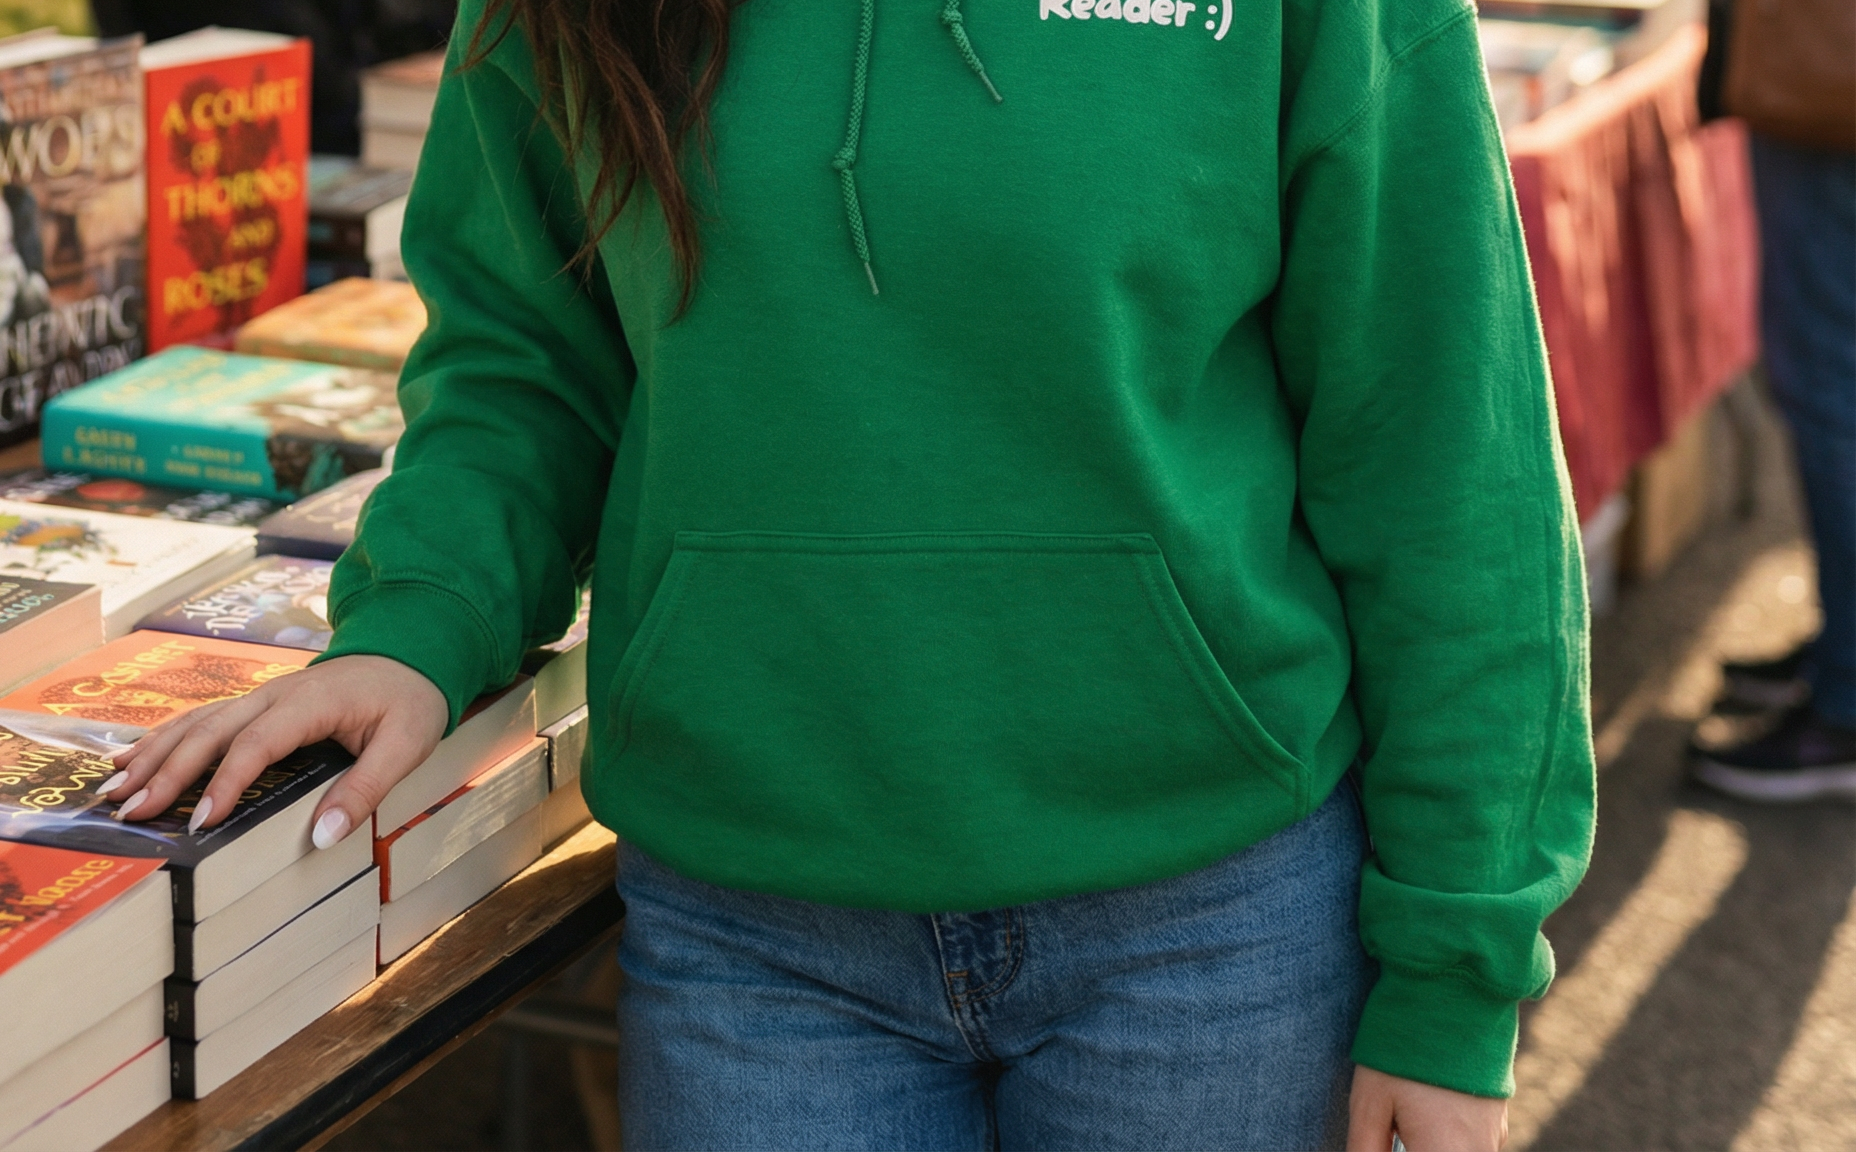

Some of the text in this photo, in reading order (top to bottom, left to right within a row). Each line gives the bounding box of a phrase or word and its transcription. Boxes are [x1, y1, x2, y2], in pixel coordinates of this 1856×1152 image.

[159, 99, 188, 137] A
[191, 76, 301, 132] COURT
[190, 137, 222, 177] OF
[163, 160, 300, 224] THORNS
[227, 216, 276, 250] AND
[163, 257, 269, 316] ROSES
